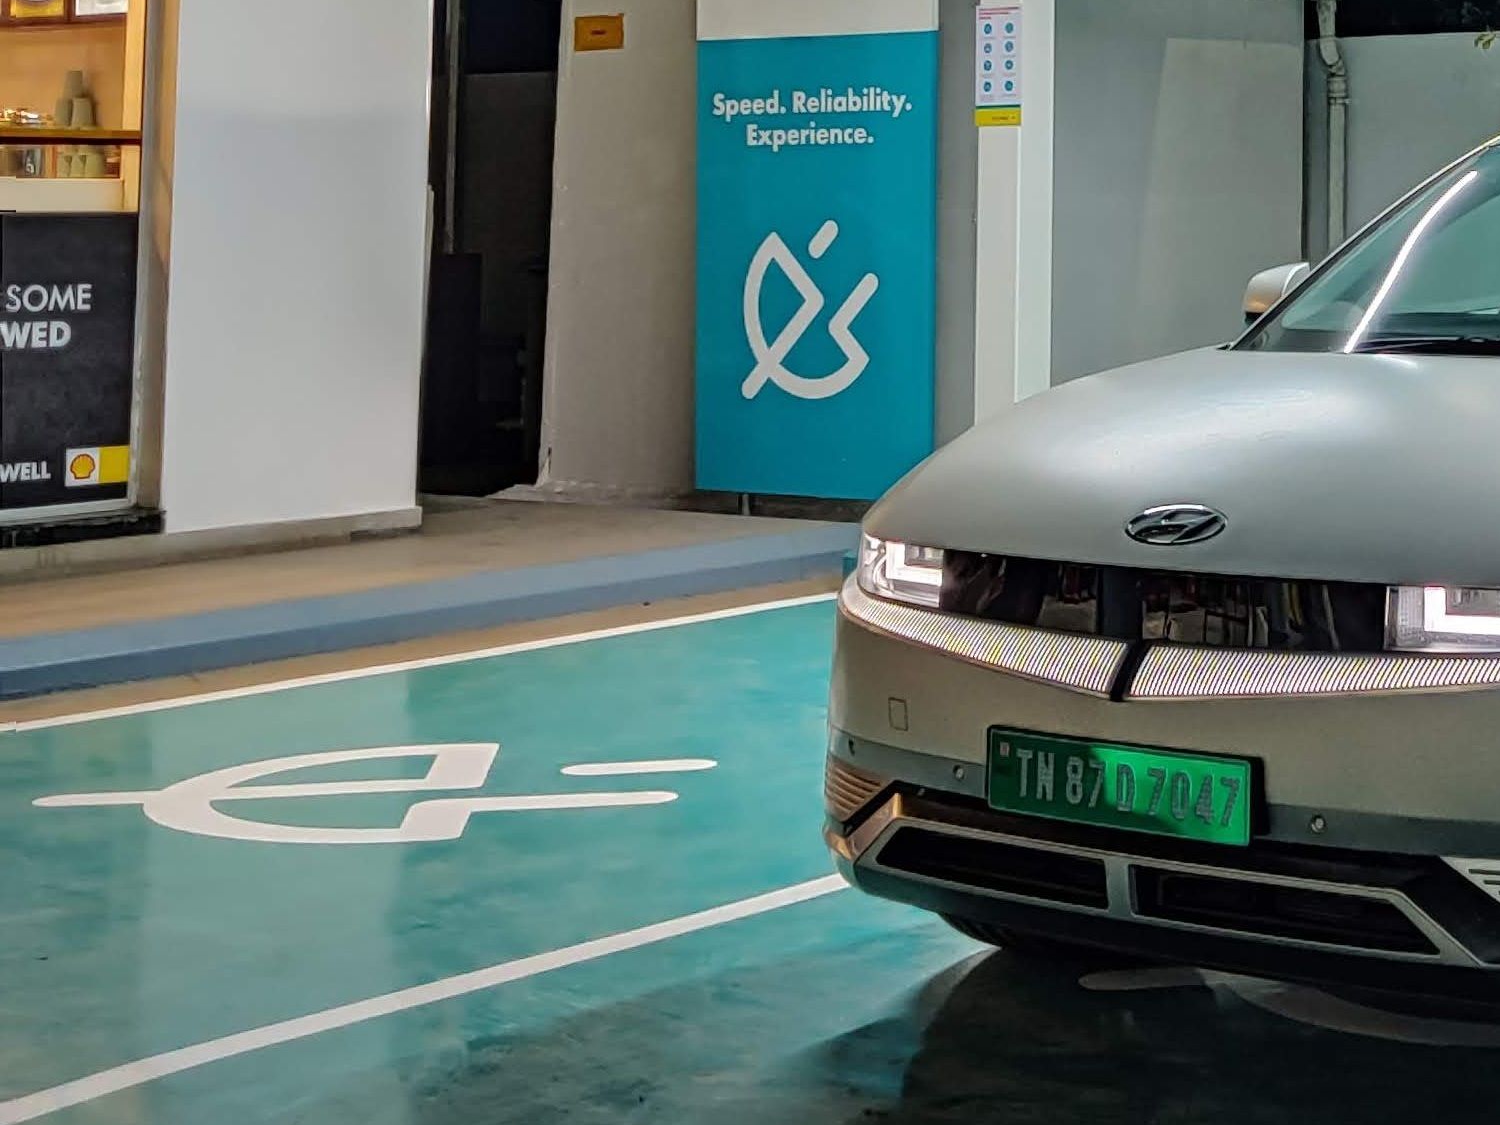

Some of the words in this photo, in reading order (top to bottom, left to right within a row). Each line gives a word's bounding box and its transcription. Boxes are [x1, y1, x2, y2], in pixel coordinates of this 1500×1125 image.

[712, 89, 787, 122] Speed.
[792, 86, 913, 118] Reliability.
[746, 121, 875, 152] Experience.
[6, 283, 93, 313] SOME
[0, 461, 51, 483] WELL
[1016, 748, 1055, 802] TN
[1066, 756, 1105, 808] 87
[1147, 766, 1241, 827] 7047
